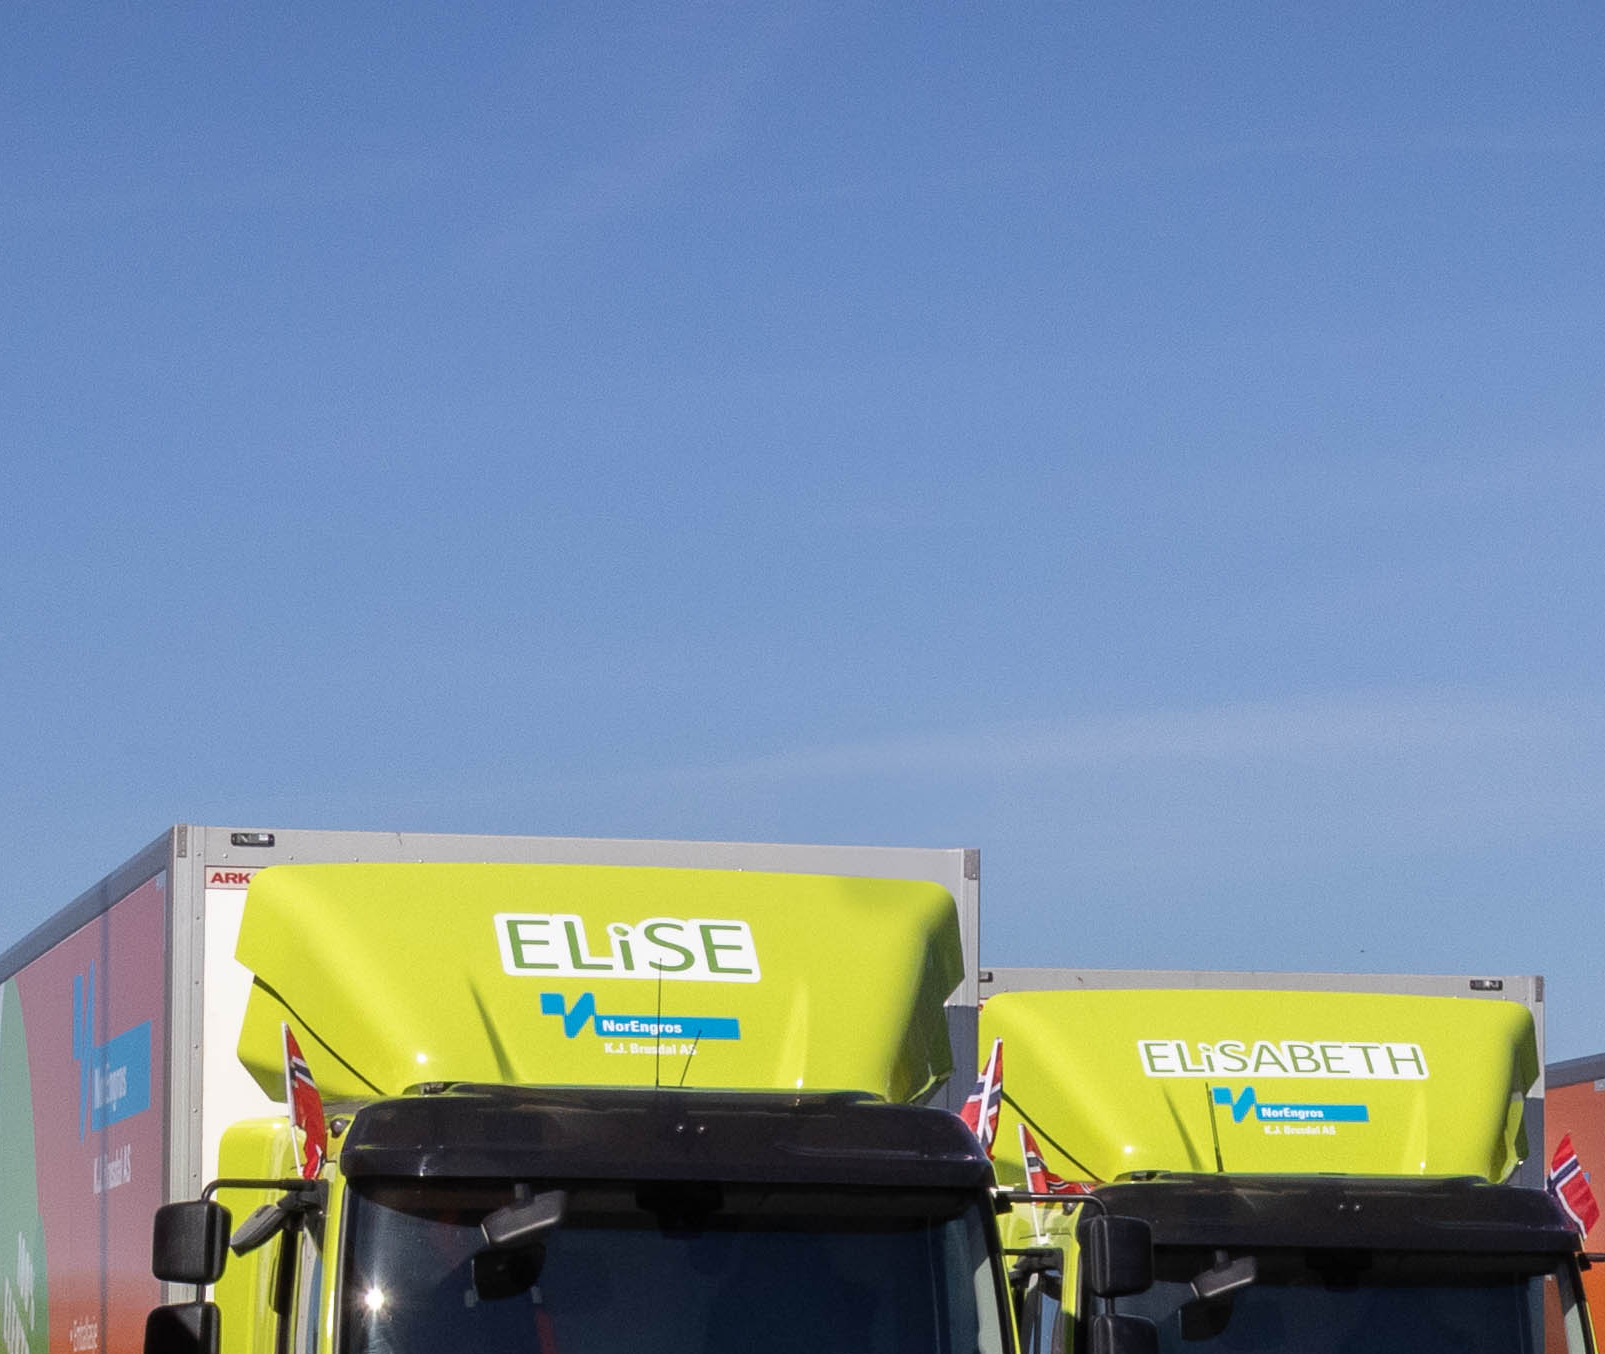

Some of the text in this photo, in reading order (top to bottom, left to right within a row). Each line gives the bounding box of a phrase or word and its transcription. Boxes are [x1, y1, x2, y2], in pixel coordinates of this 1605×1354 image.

[211, 872, 252, 884] ARK
[506, 920, 753, 974] ELiSE
[602, 1019, 683, 1036] NorEngros
[680, 1044, 697, 1056] AS
[1144, 1043, 1425, 1075] ELiSABETH
[1261, 1107, 1324, 1120] NorEngros
